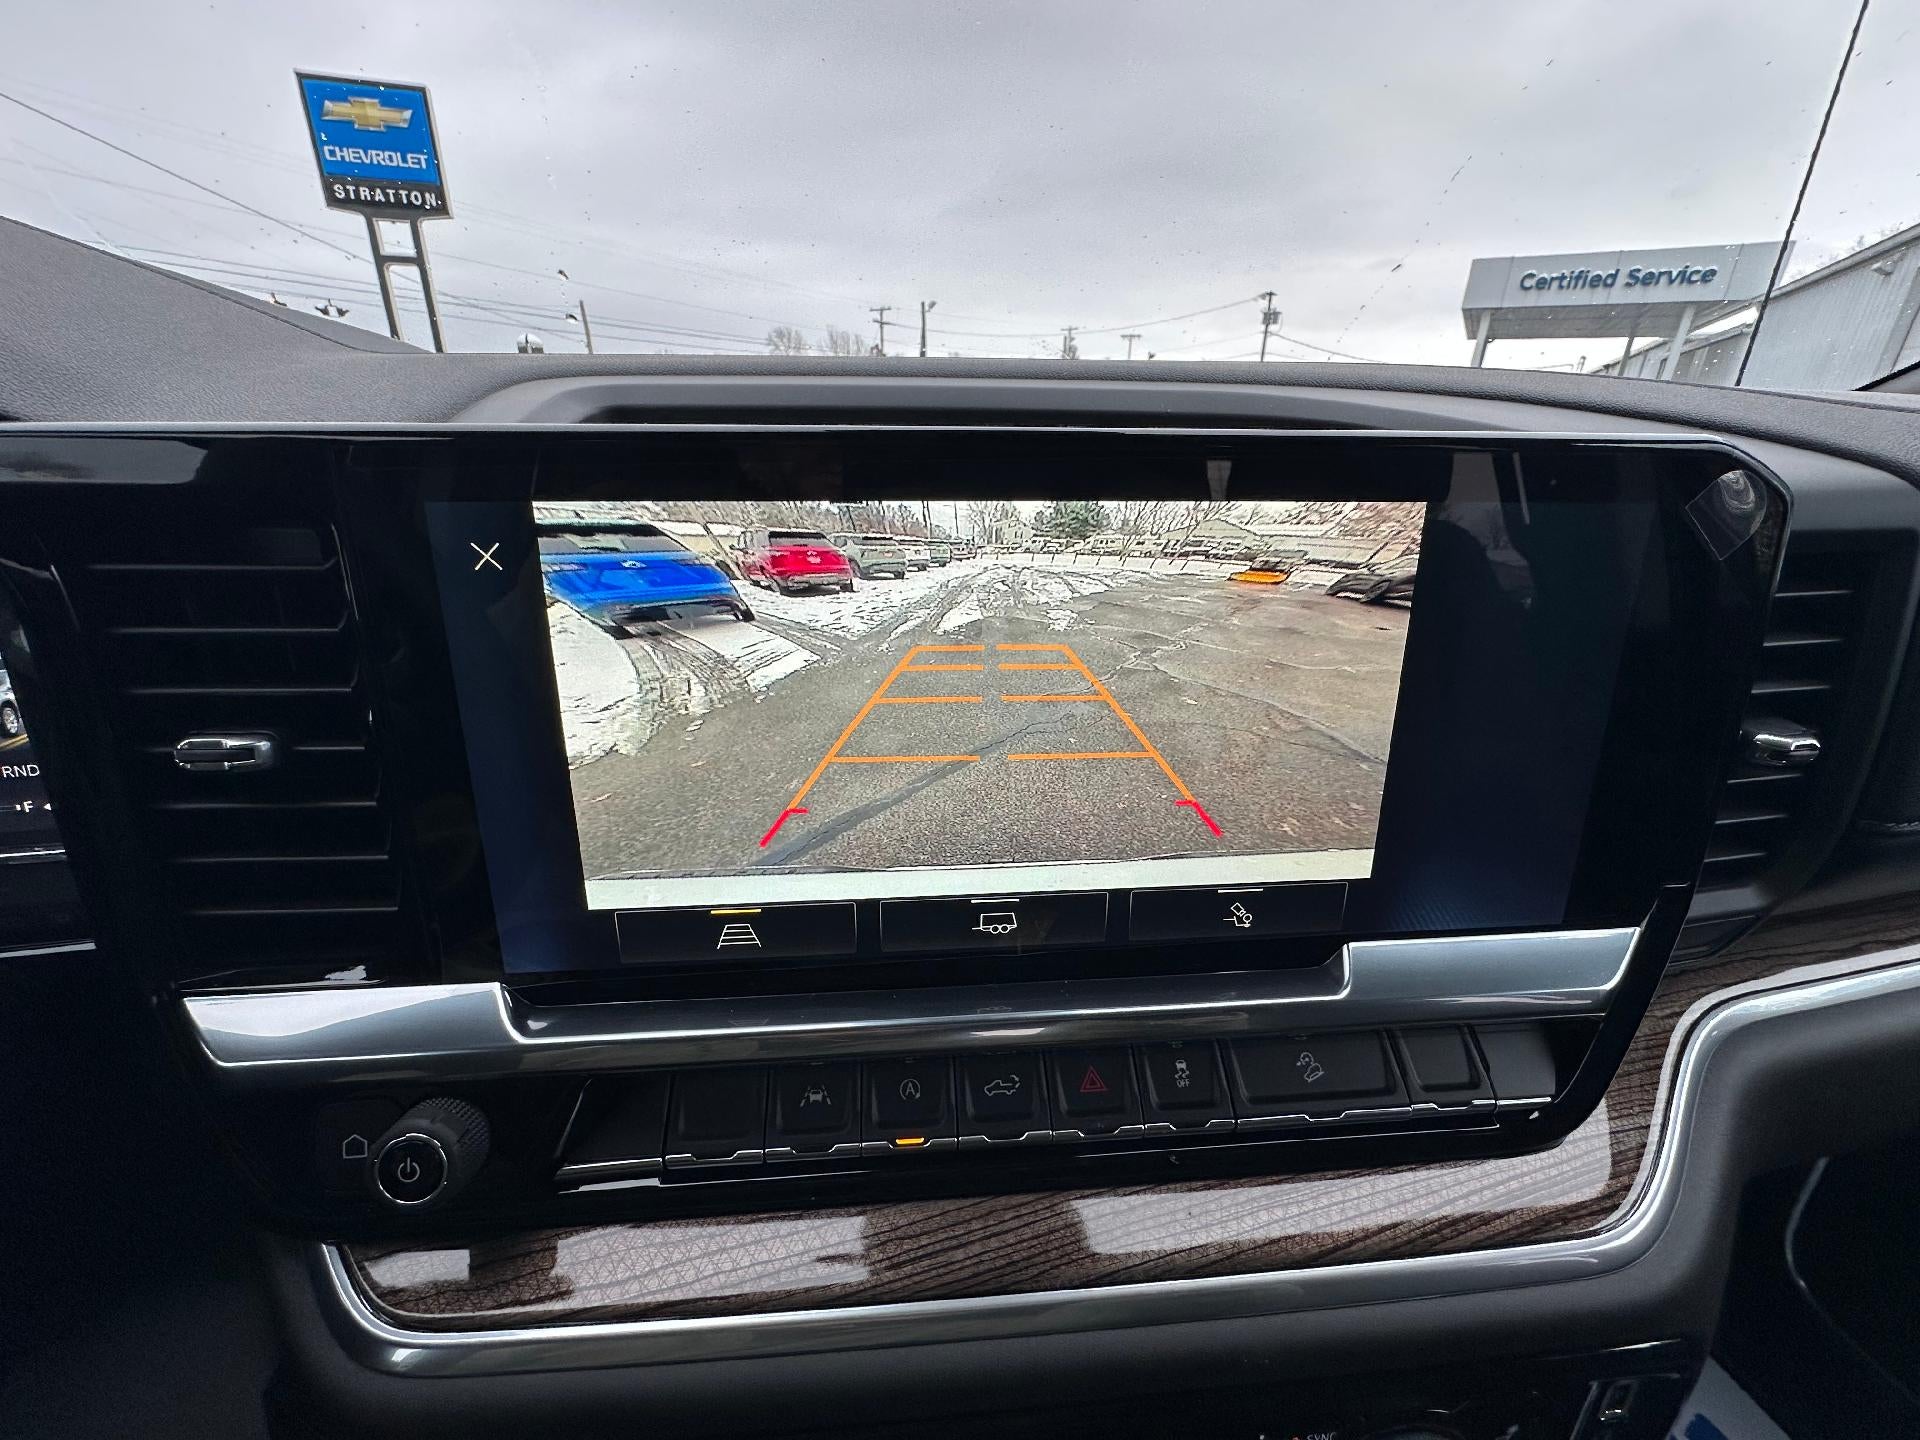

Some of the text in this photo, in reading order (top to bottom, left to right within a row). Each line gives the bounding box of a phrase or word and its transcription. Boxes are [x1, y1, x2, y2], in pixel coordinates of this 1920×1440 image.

[323, 145, 428, 170] CHEVROLET
[333, 183, 437, 208] STRATTON
[1519, 263, 1718, 291] Certified Service
[1176, 1078, 1190, 1088] OFF
